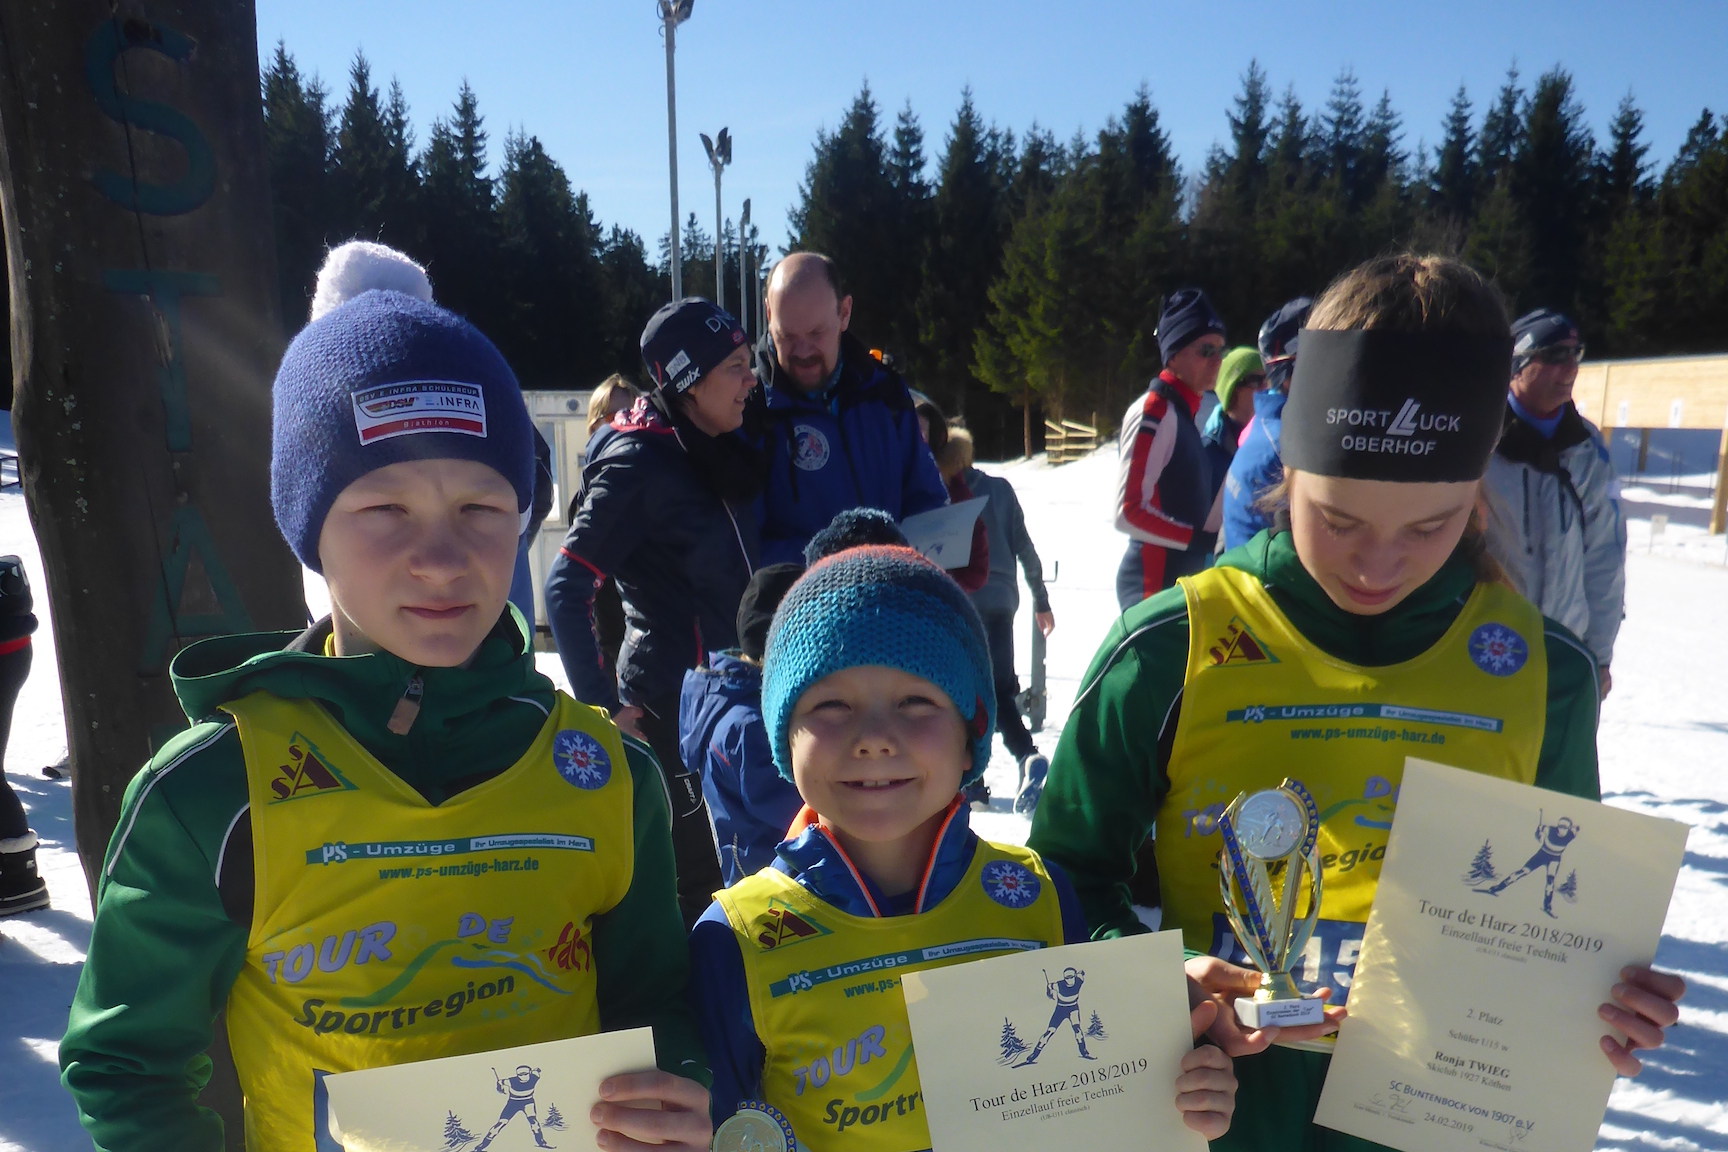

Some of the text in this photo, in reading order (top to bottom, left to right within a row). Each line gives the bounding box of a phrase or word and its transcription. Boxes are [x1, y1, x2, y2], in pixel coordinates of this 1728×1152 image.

[390, 385, 417, 395] INFRA
[404, 420, 450, 428] Biathlon
[1341, 435, 1437, 456] OBERHOF
[1243, 706, 1364, 721] PS Umzüge
[1290, 726, 1445, 744] www.ps-umzüge-harz.de
[322, 843, 456, 863] PS Umzüge
[379, 857, 539, 880] www.ps-umzüge-harz.de
[457, 912, 514, 944] DE
[1418, 899, 1604, 953] Tour de Harz 2018/2019
[262, 921, 397, 984] TOUR
[1441, 924, 1568, 964] Einzellauf freie Technik
[788, 955, 908, 991] PS Umzüge
[843, 977, 903, 998] www.ps-
[294, 975, 515, 1036] Sportregion
[1466, 1008, 1503, 1027] 2. Platz
[793, 1024, 887, 1096] TOUR
[1434, 1050, 1511, 1079] Ronja TWIEG
[969, 1057, 1148, 1112] Tour de Harz 2018/2019
[1426, 1061, 1512, 1092] Skiclub 1927 Köthen
[823, 1091, 923, 1132] Sportr
[1001, 1084, 1125, 1121] Einzellauf freie Technik
[1389, 1080, 1403, 1093] SC
[1491, 1111, 1516, 1126] 1907
[1423, 1112, 1474, 1134] 24.02.2019
